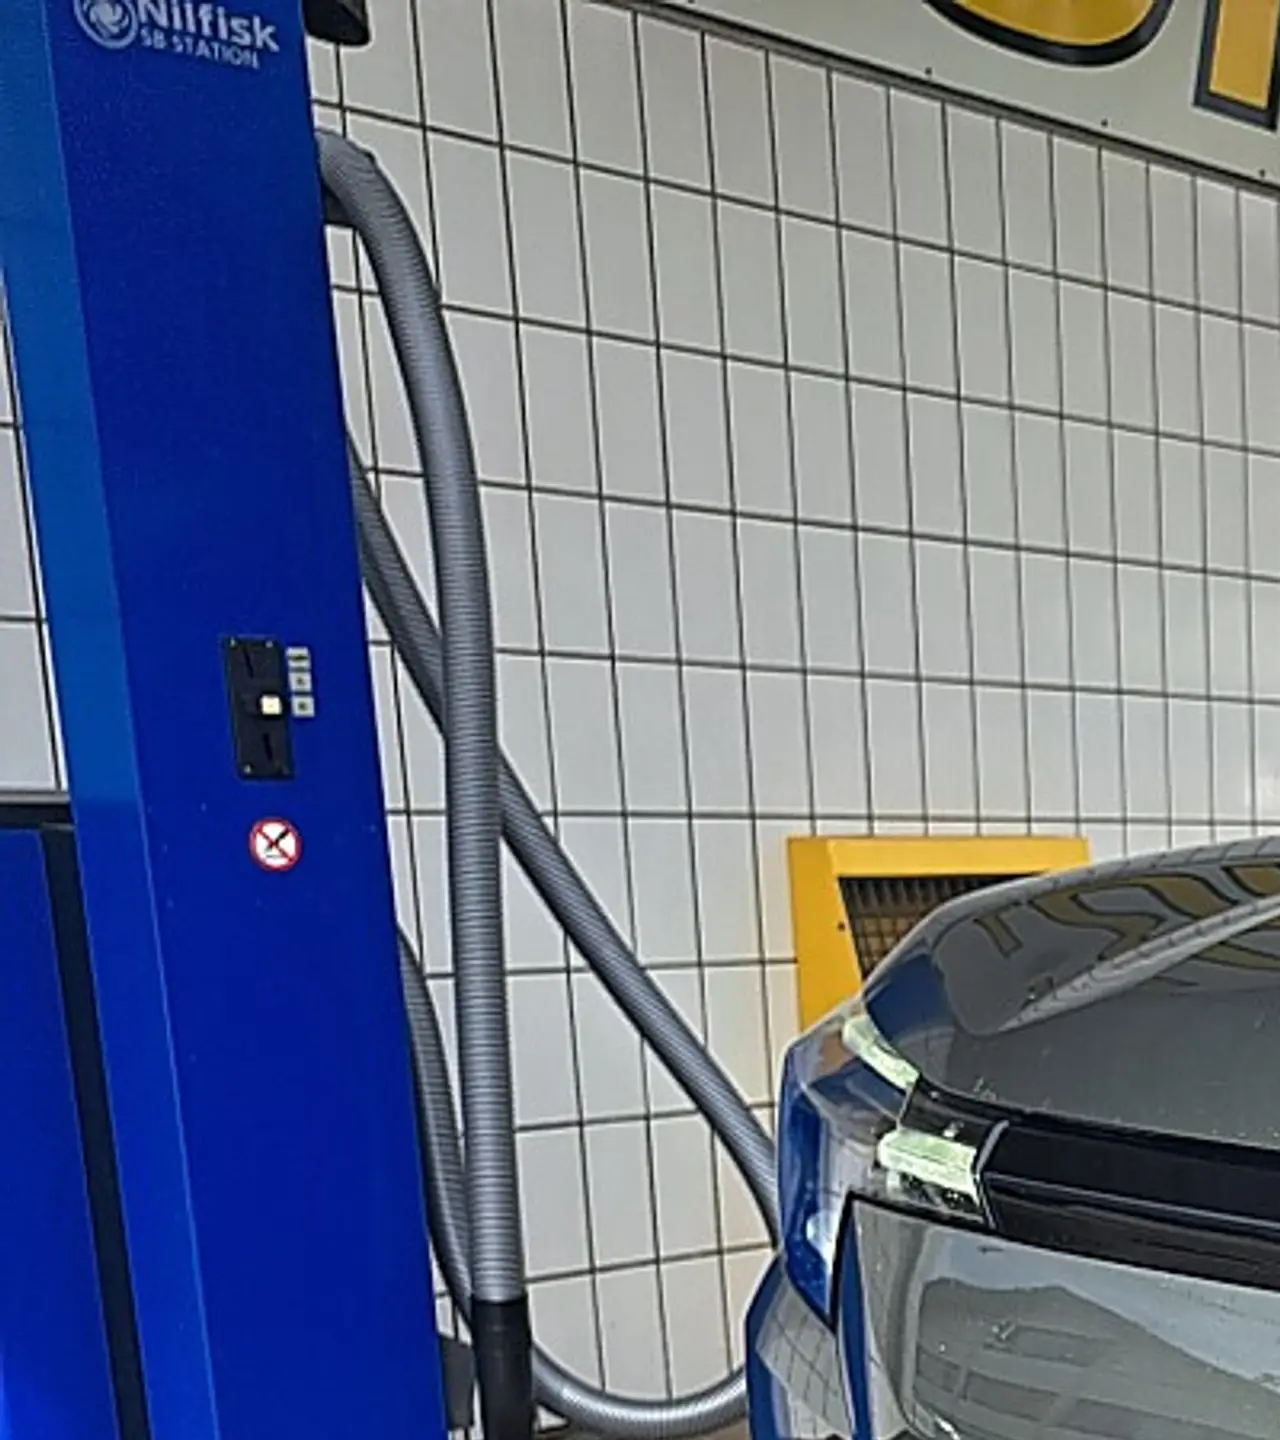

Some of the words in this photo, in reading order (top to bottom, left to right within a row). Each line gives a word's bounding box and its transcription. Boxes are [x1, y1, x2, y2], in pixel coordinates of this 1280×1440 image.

[135, 0, 280, 52] Nilfisk
[139, 26, 168, 49] SB
[171, 33, 259, 69] STATION
